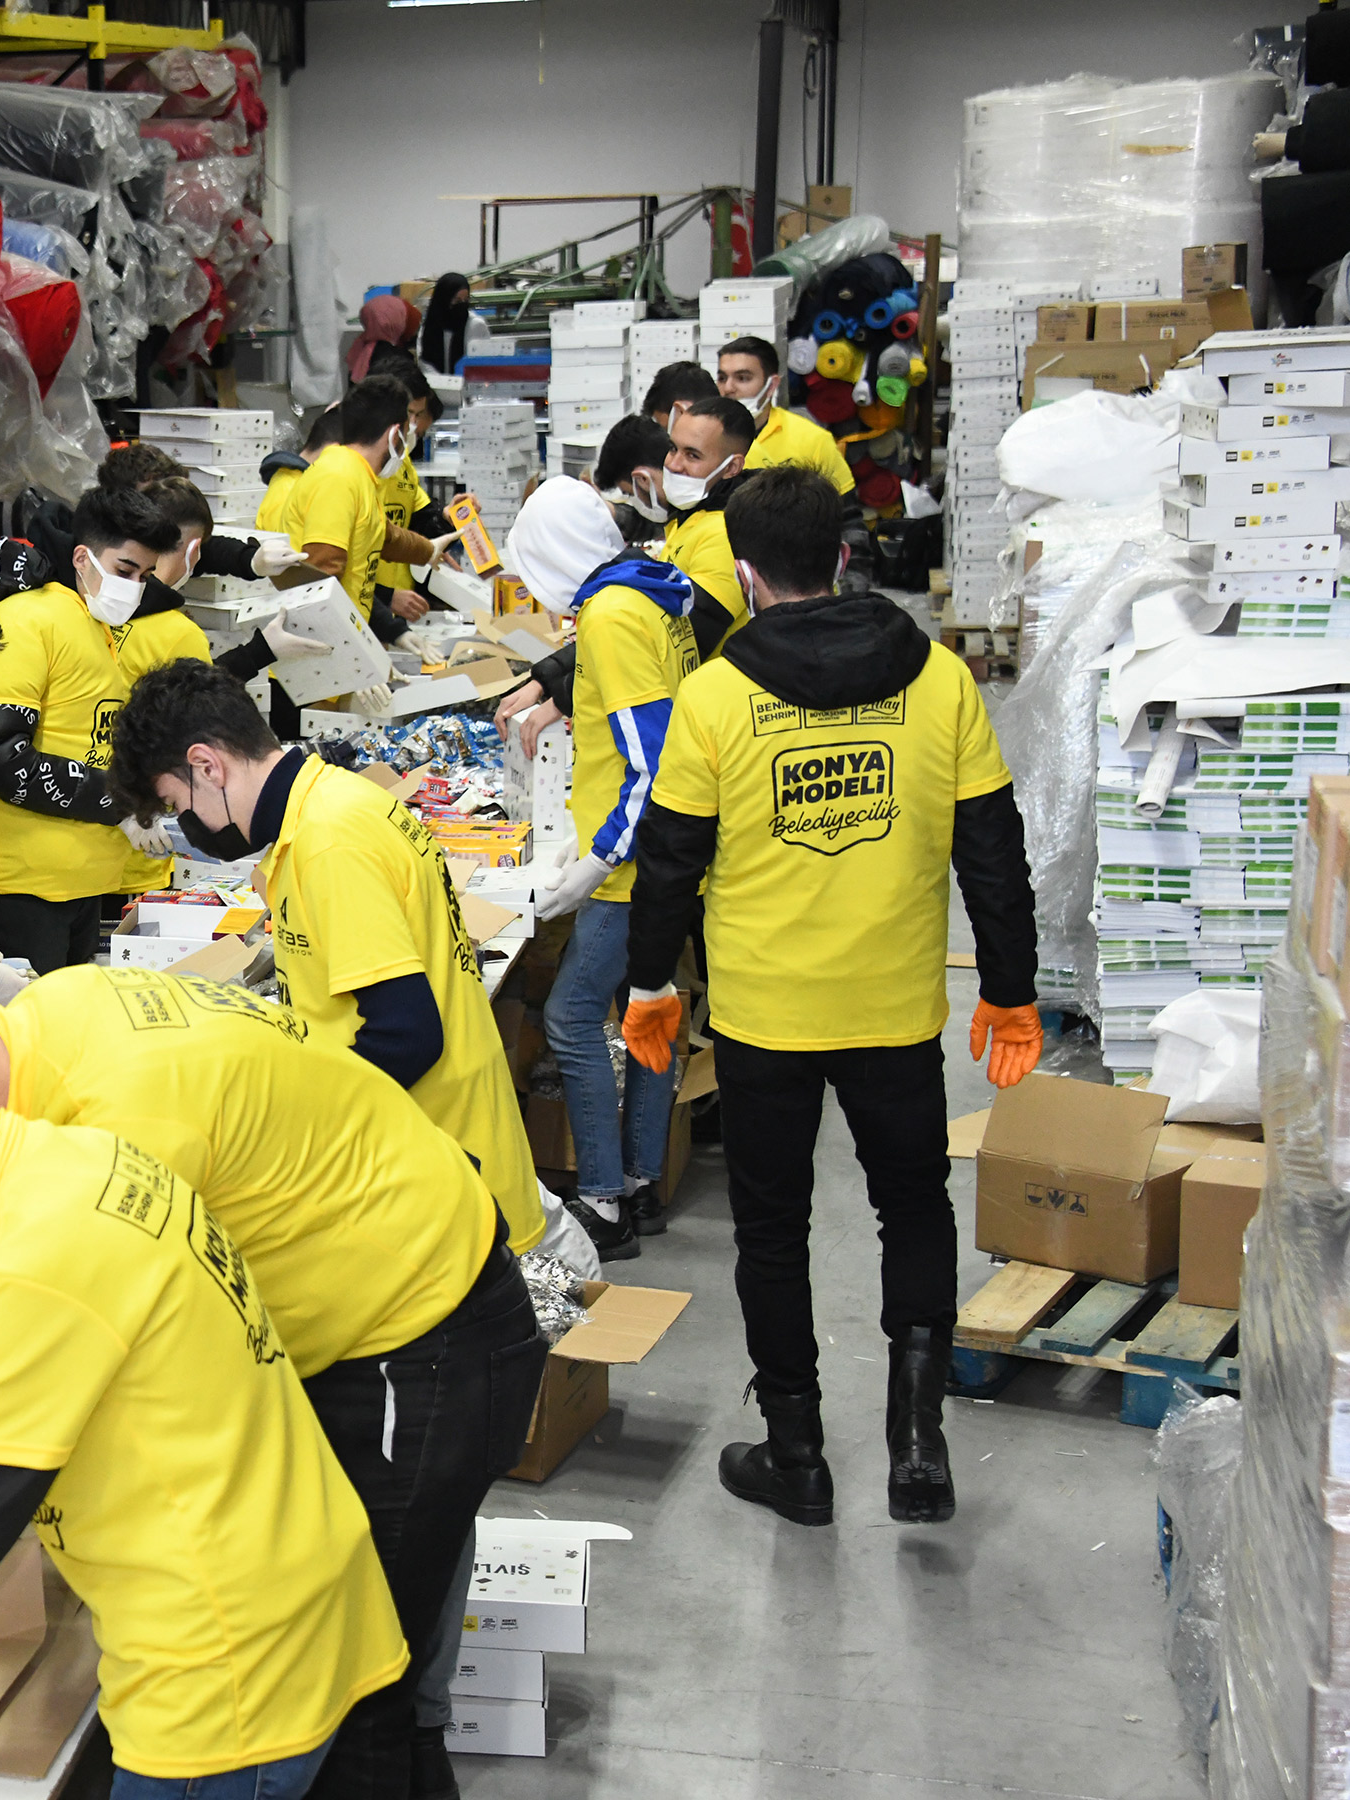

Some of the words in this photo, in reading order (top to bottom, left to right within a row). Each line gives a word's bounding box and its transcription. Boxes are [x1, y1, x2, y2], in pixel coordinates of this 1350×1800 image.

[757, 710, 797, 725] ŞEHRİM
[782, 750, 886, 786] KONYA
[781, 774, 886, 807] MODELİ
[768, 797, 901, 840] Belediyecilik
